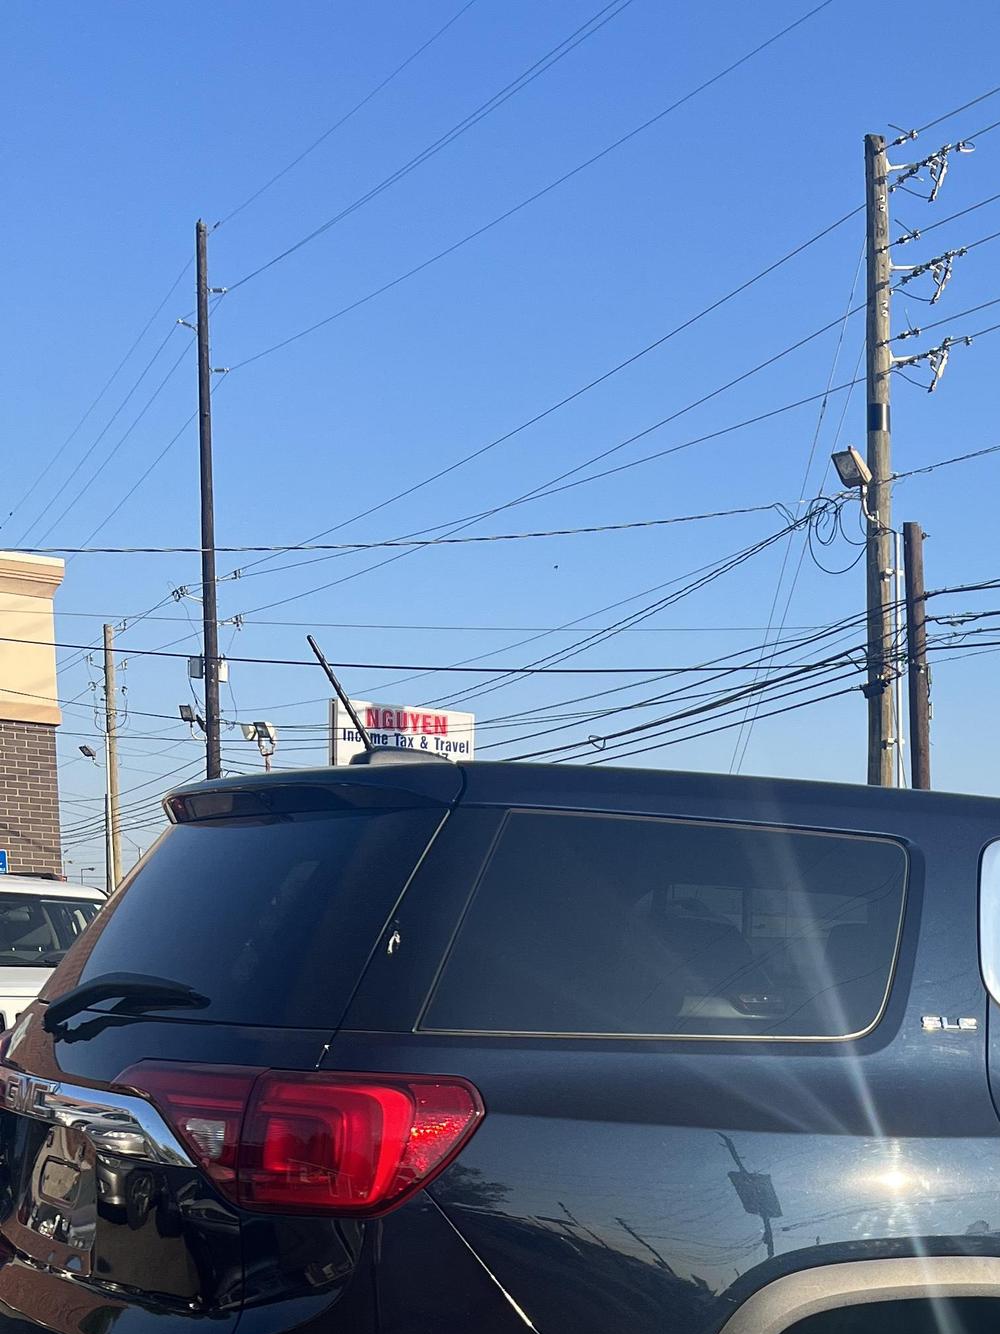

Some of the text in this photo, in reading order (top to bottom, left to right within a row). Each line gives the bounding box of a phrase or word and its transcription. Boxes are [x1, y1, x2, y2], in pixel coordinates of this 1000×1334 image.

[365, 707, 448, 736] NGUYEN
[342, 728, 469, 754] Incme Tax & Travel
[5, 1074, 58, 1119] GMC
